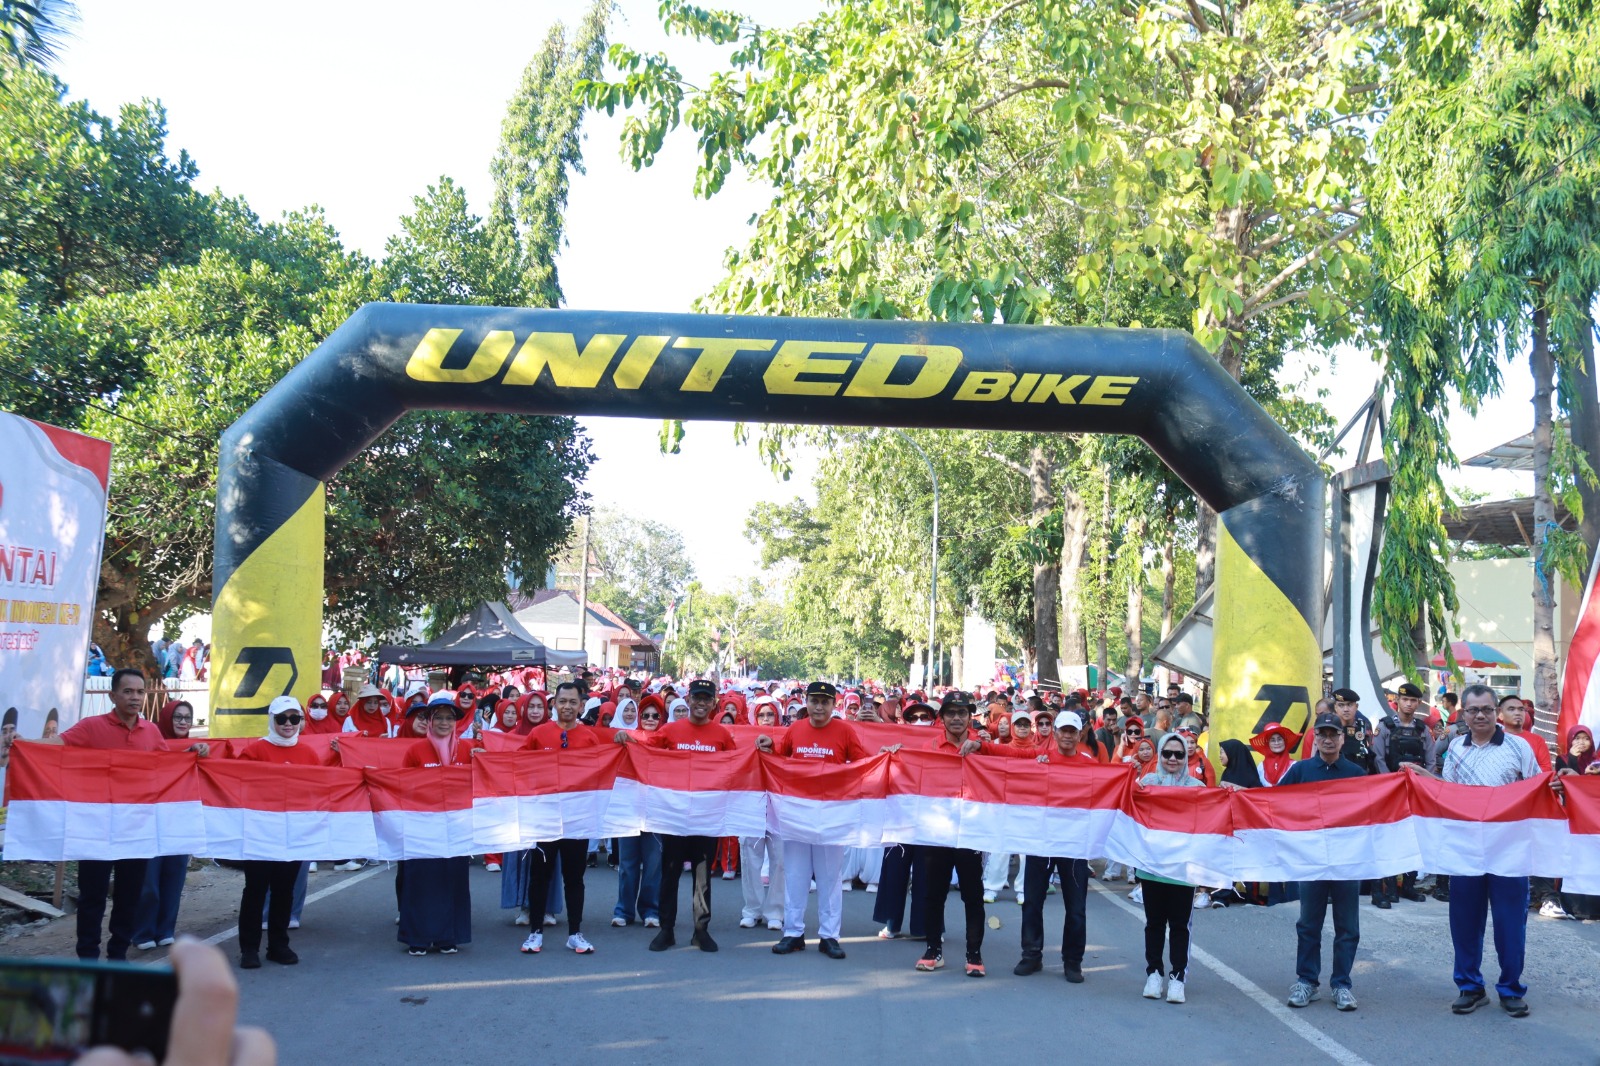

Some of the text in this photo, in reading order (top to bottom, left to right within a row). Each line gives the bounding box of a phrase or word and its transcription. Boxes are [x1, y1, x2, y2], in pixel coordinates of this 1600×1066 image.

[405, 327, 1140, 406] UNITED BIKE
[677, 743, 716, 752] INDONESIA
[796, 746, 834, 755] INDONESIA
